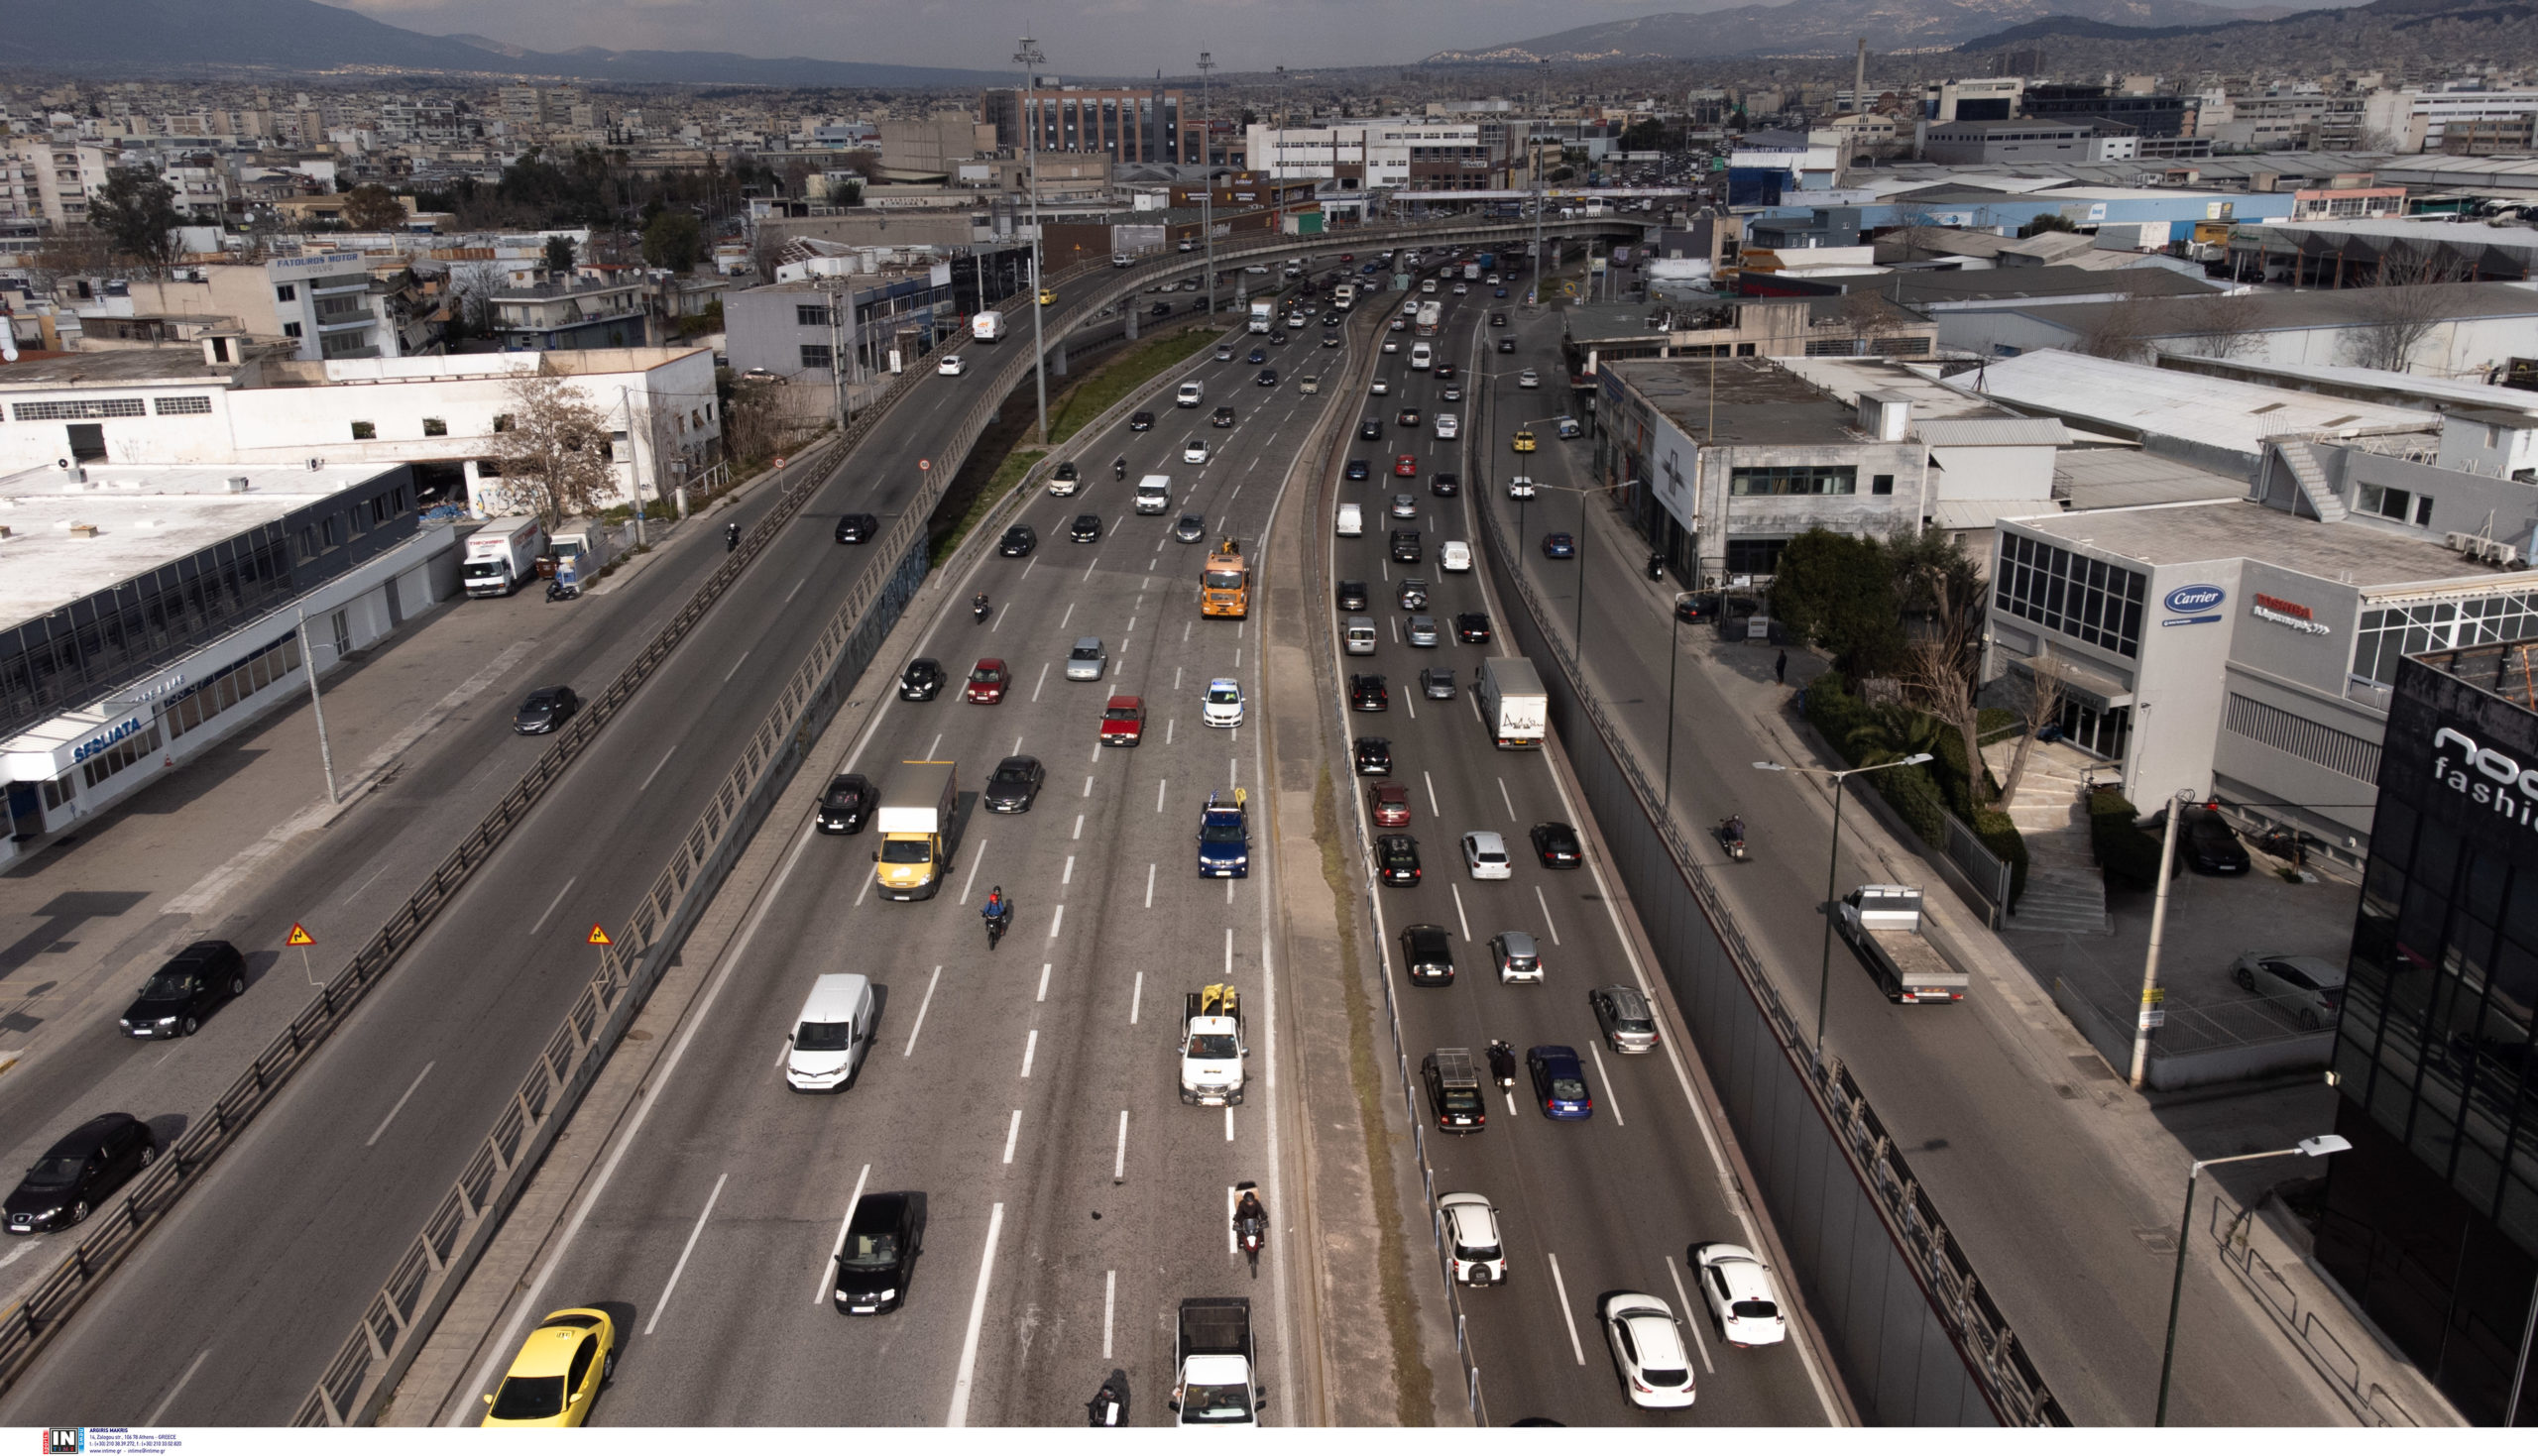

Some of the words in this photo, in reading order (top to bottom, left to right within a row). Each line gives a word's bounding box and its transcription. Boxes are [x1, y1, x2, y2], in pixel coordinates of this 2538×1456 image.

[278, 257, 325, 268] FATOUROS
[328, 253, 358, 263] MOTOR
[2174, 591, 2219, 606] Carrier
[2256, 592, 2314, 620] TOSHIBA
[71, 717, 142, 764] SFOLIATA
[2435, 756, 2538, 834] fashi
